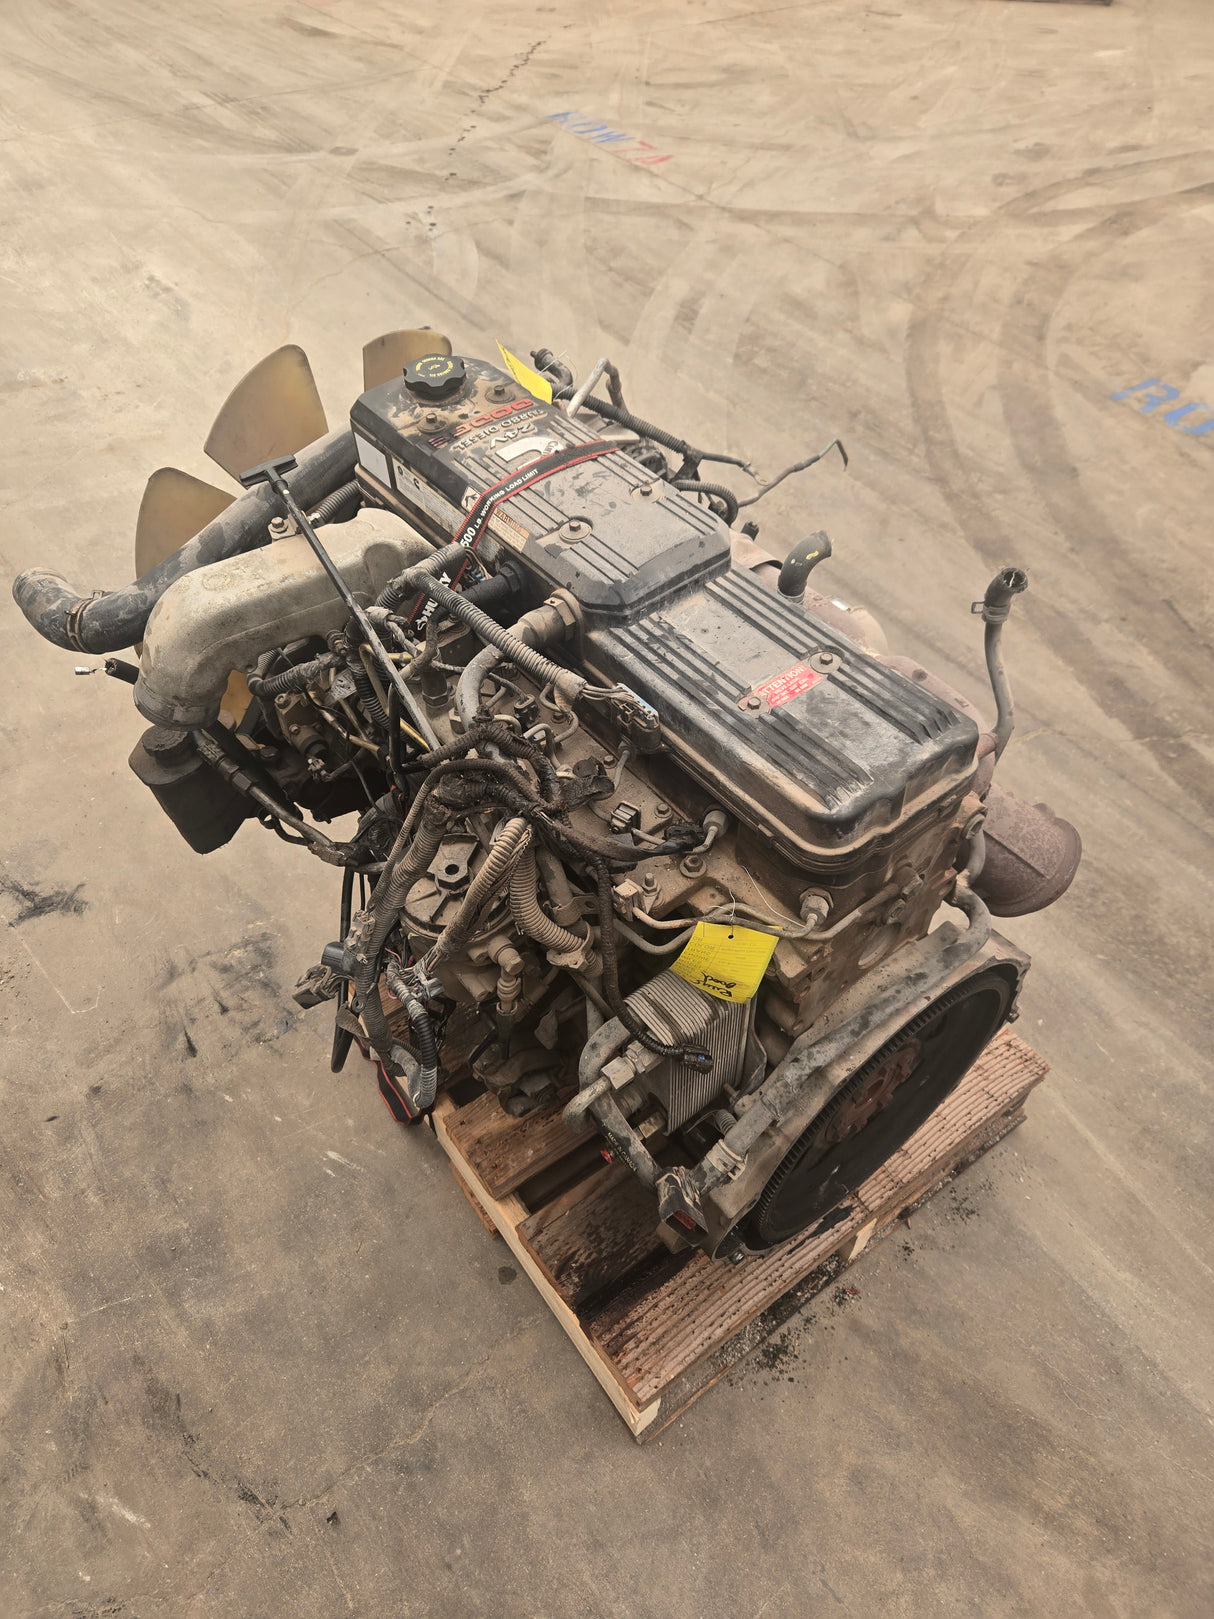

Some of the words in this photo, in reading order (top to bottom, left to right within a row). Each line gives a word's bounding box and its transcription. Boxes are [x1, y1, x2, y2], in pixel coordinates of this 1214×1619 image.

[428, 399, 534, 447] DODGE
[490, 423, 536, 450] 24V
[501, 409, 545, 428] TURBO
[452, 425, 499, 450] DIESEL
[481, 490, 505, 517] WORKING
[505, 479, 523, 491] LOAD
[522, 468, 539, 481] LIMIT
[422, 571, 452, 617] HUY
